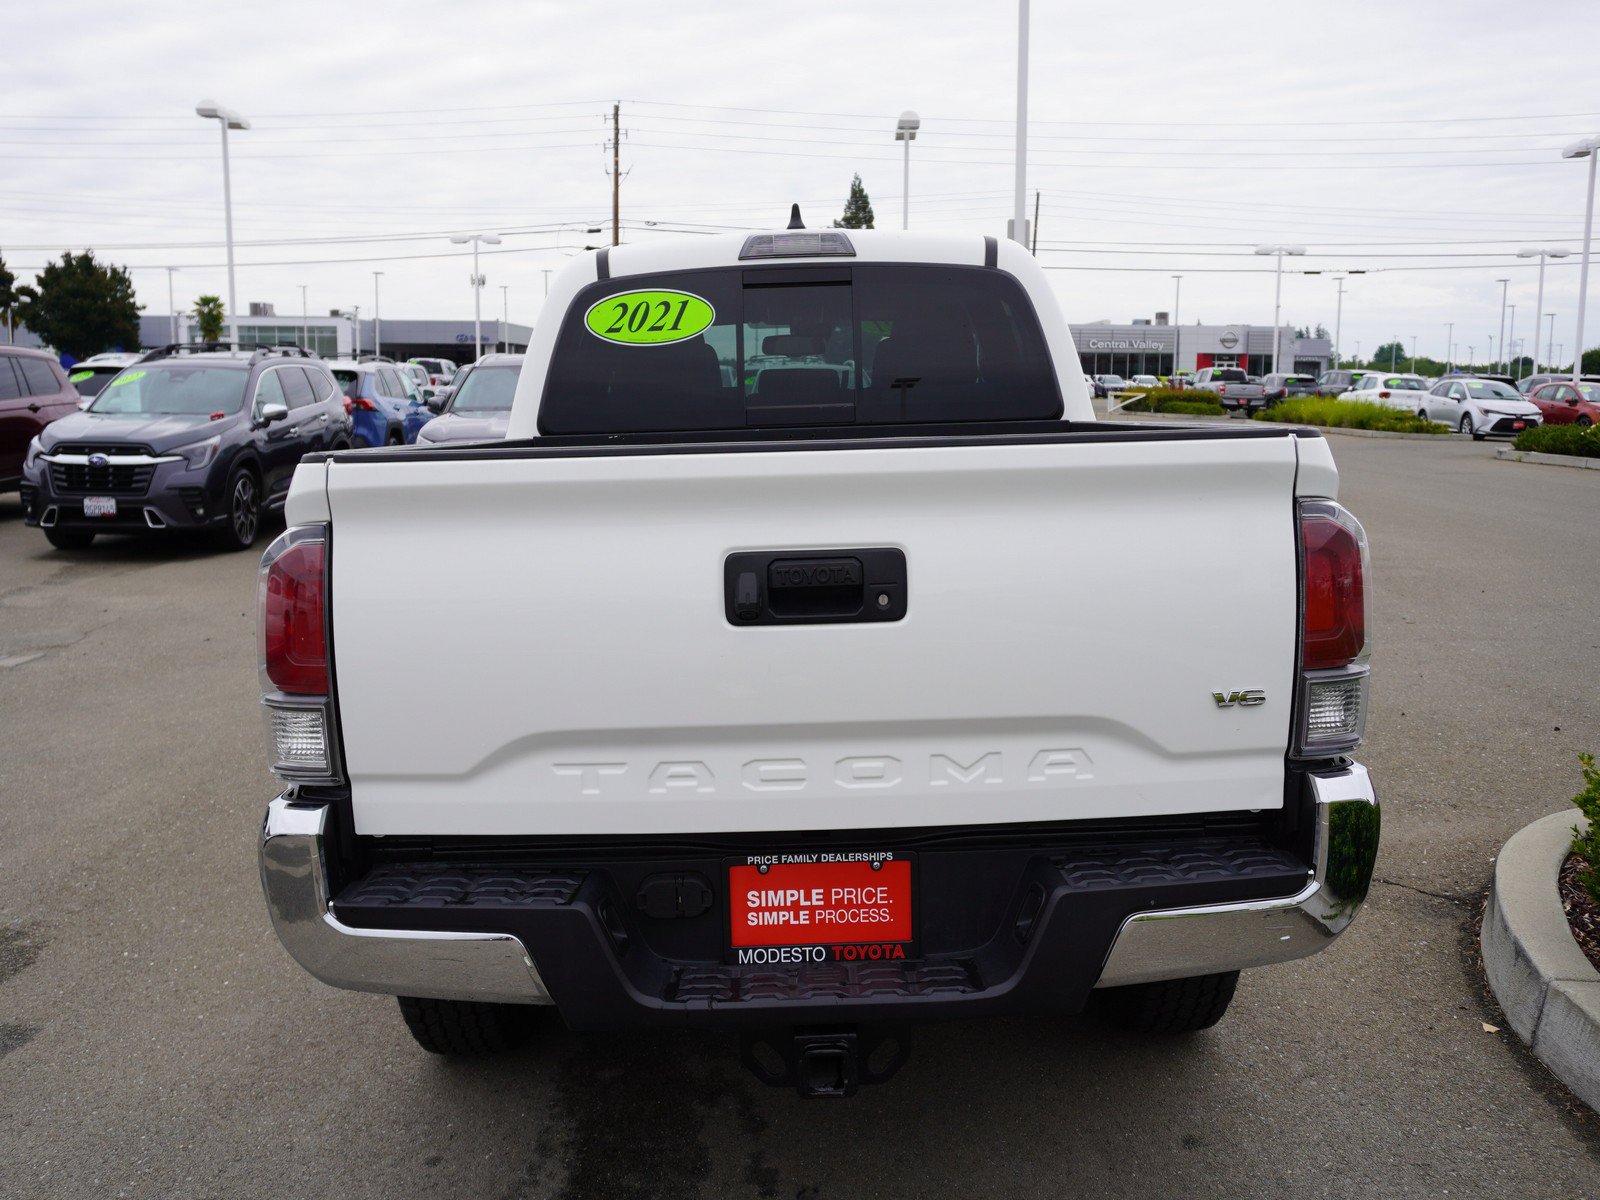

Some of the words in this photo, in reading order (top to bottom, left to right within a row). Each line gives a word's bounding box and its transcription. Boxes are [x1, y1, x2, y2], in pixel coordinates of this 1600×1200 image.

[604, 299, 690, 334] 2021
[1089, 339, 1129, 349] Central
[1131, 339, 1165, 351] Valley
[776, 566, 856, 586] TOYOTA
[1212, 689, 1267, 708] V6
[551, 748, 1095, 795] TACOMA
[747, 855, 779, 865] PRICE
[781, 854, 818, 864] FAMILY
[821, 852, 893, 862] DEALERSHIPS
[747, 889, 824, 907] SIMPLE
[831, 887, 893, 905] PRICE.
[747, 910, 810, 926] SIMPLE
[815, 908, 894, 924] PROCESS.
[738, 946, 826, 965] MODESTO
[832, 945, 905, 961] TOYOTA
